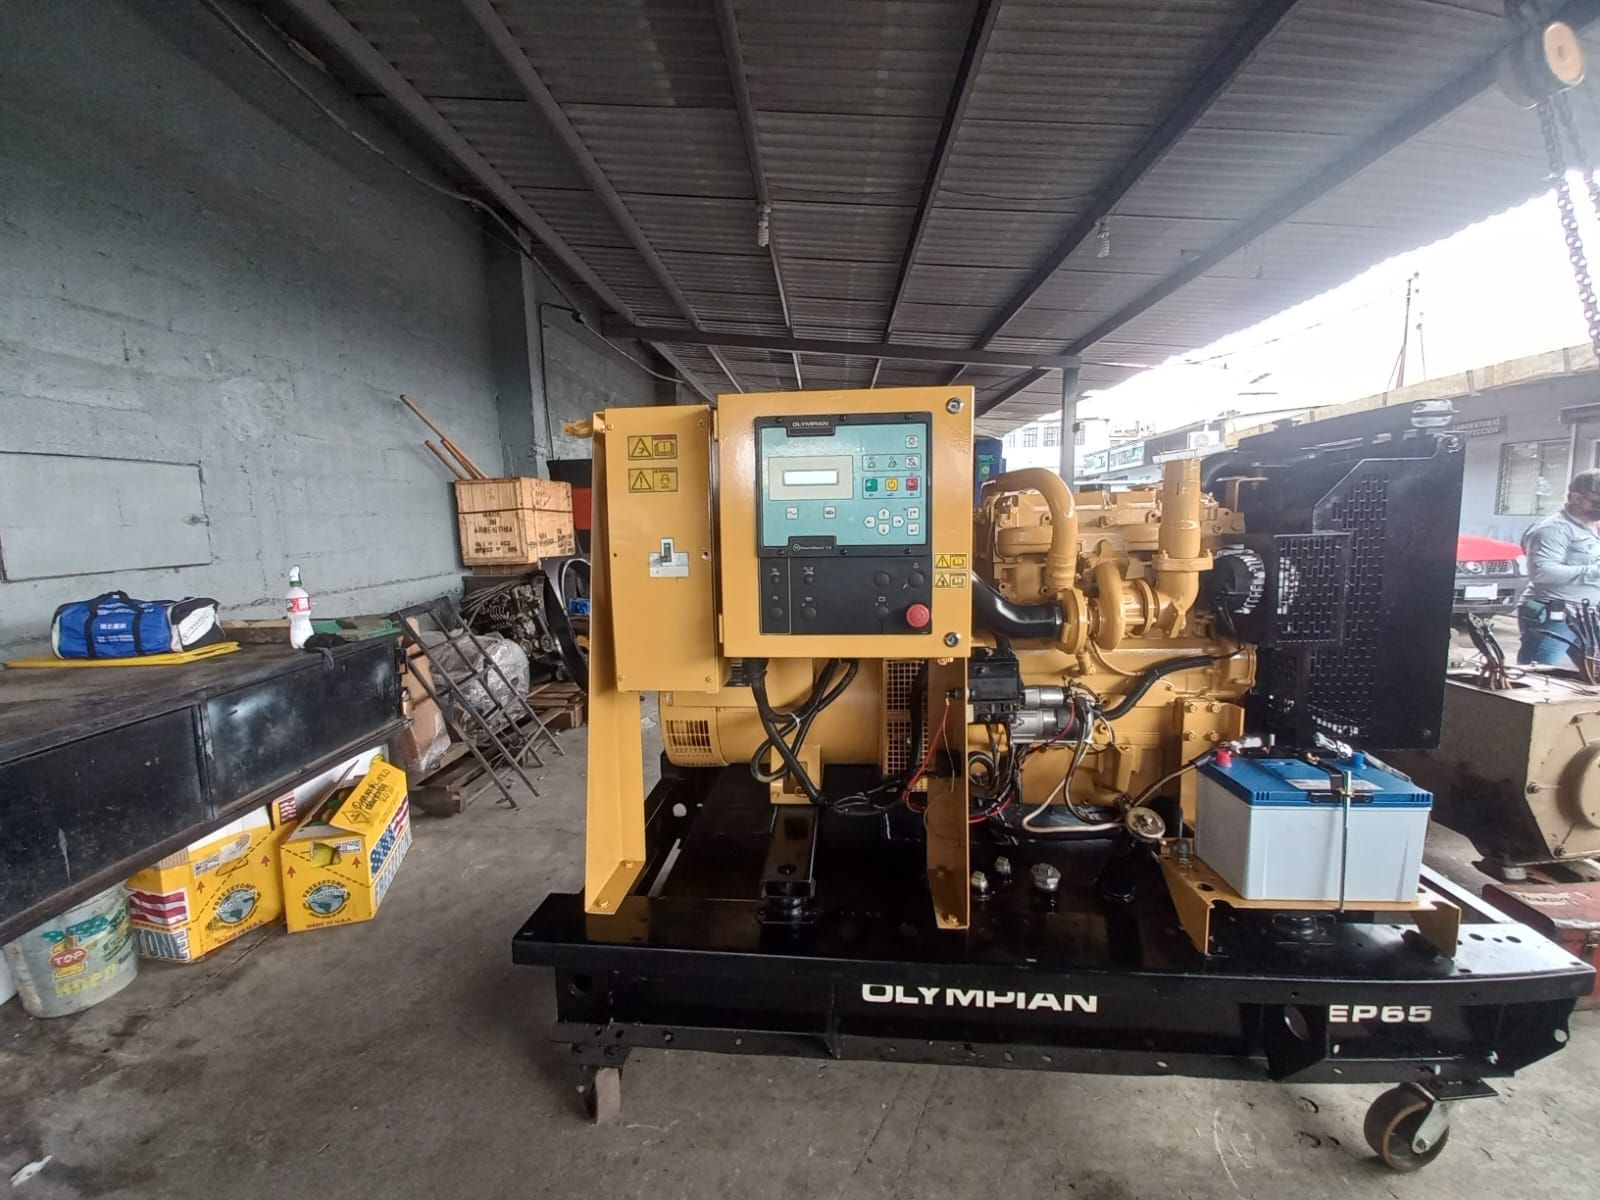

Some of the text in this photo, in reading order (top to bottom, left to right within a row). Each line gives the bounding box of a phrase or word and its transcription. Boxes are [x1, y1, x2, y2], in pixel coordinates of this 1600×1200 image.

[53, 950, 86, 966] TOP
[862, 983, 1098, 1013] OLYMPIAN
[1328, 1004, 1433, 1023] EP65
